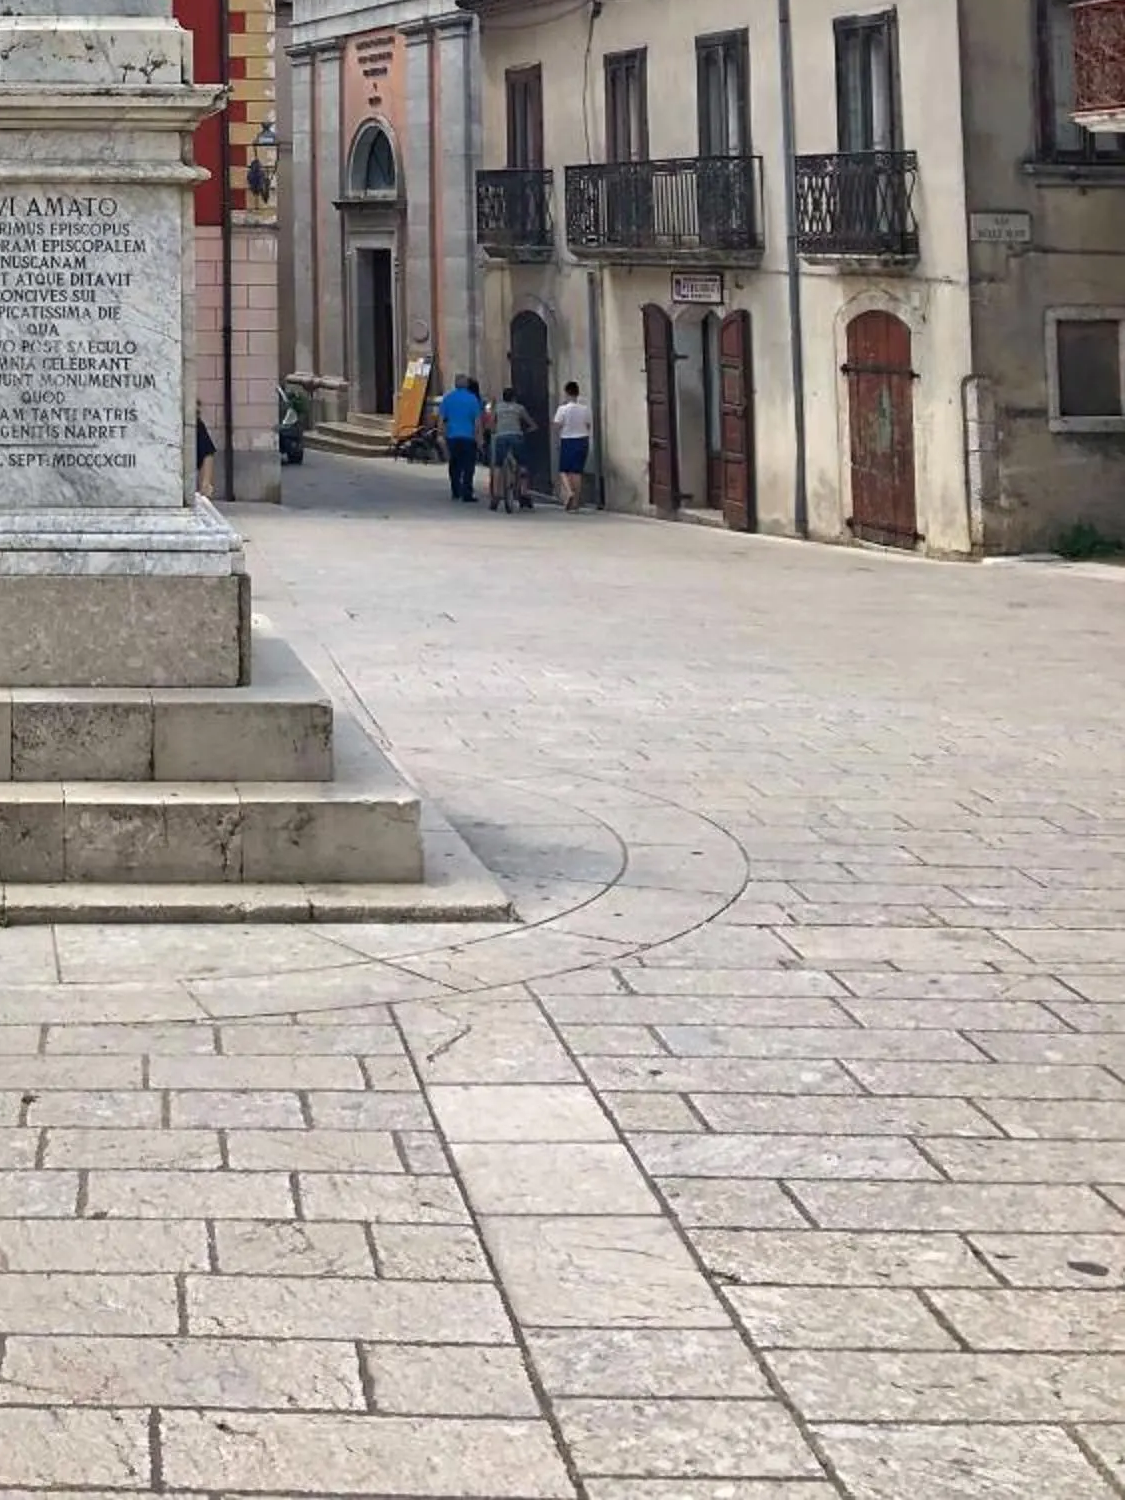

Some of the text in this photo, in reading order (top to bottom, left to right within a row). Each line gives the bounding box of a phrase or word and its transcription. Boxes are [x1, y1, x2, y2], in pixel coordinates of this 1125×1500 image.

[26, 197, 118, 217] AMATO
[50, 223, 130, 236] EPISCOPUS
[42, 239, 146, 253] EPISCOPALEM
[0, 256, 87, 269] NUSCANAM
[15, 272, 64, 286] ATQUE
[70, 273, 133, 287] DITAVIT
[73, 290, 96, 303] SUI
[98, 307, 121, 320] DIE
[26, 324, 60, 337] QUA
[66, 340, 137, 355] SAECULO
[42, 357, 132, 371] CELEBRANT
[40, 373, 156, 389] MONUMENTUM
[21, 391, 66, 404] QUOD
[31, 408, 77, 421] TANTI
[82, 408, 139, 421] PATRIS
[65, 425, 127, 439] NARRET
